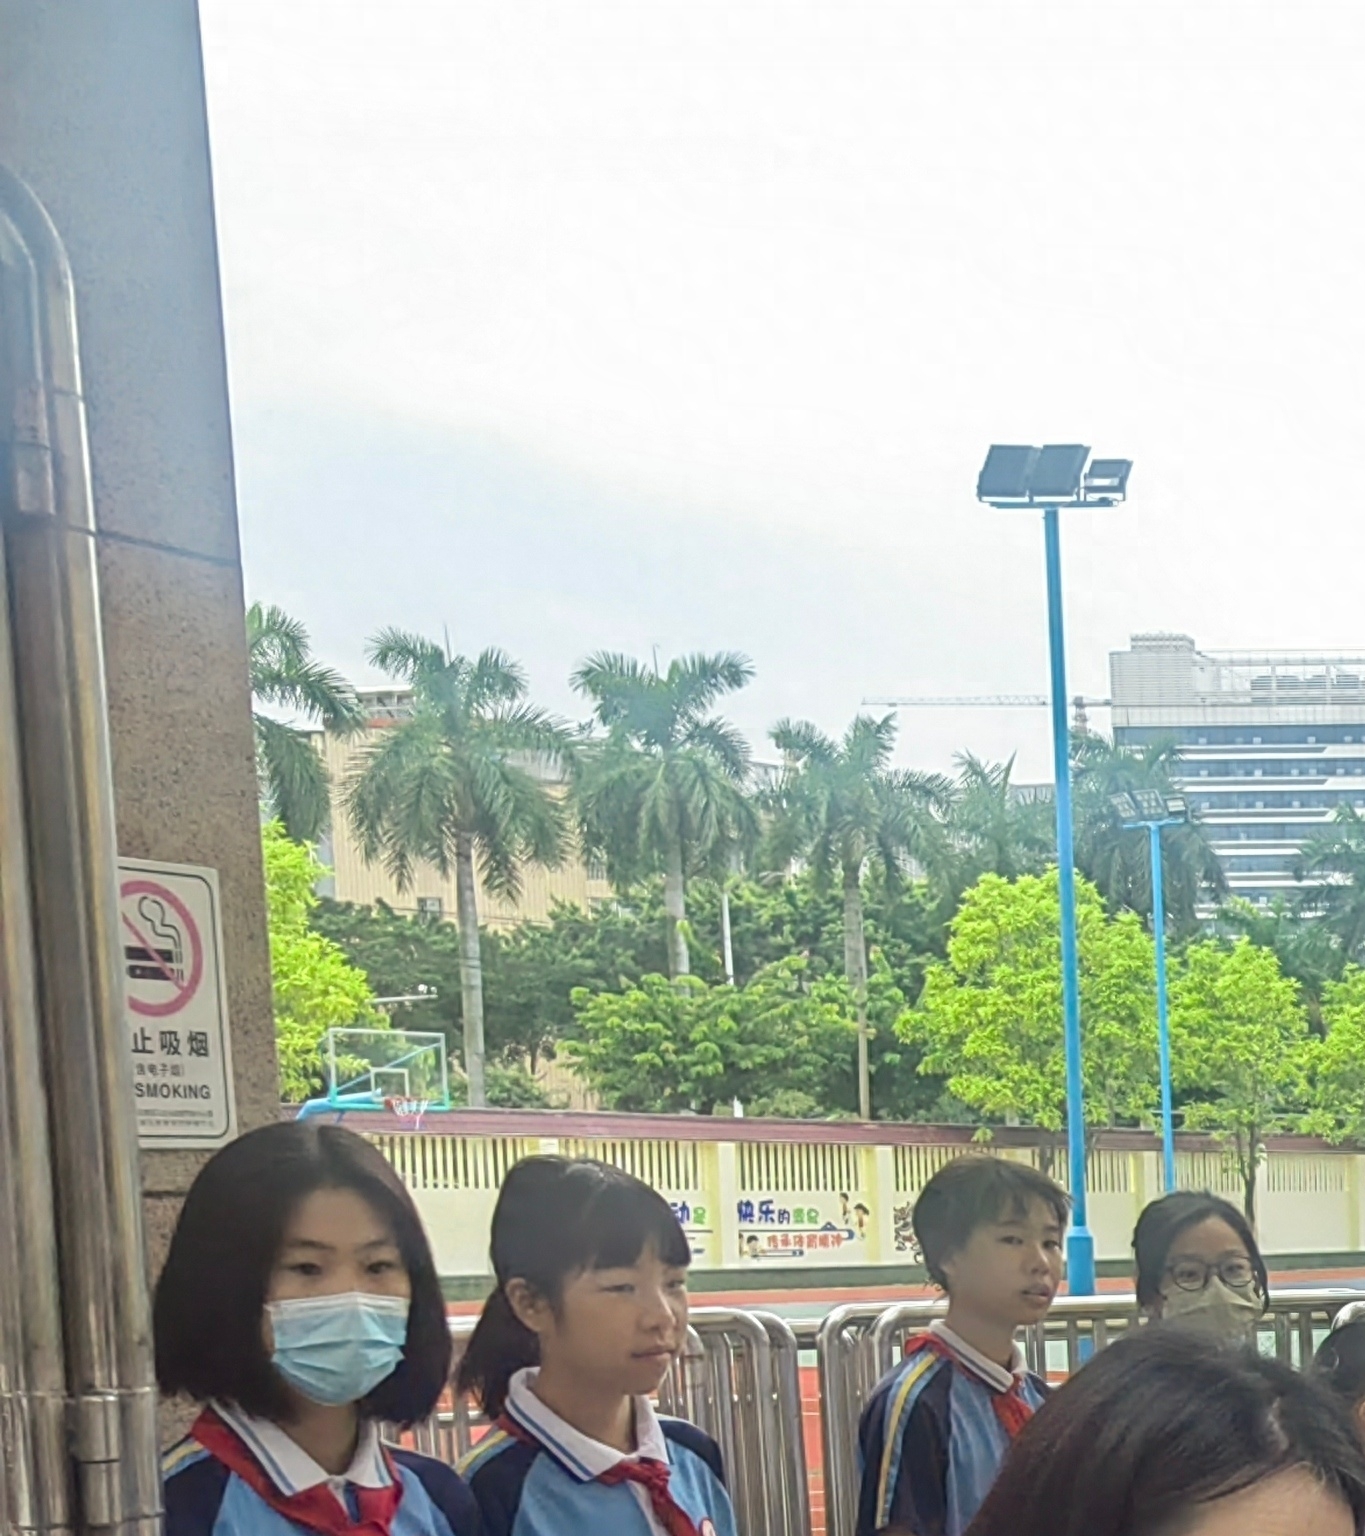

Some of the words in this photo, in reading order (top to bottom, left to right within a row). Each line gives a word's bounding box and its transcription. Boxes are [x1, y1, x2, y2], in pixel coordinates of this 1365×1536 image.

[131, 1026, 209, 1058] 止吸烟
[135, 1082, 211, 1099] SMOKING
